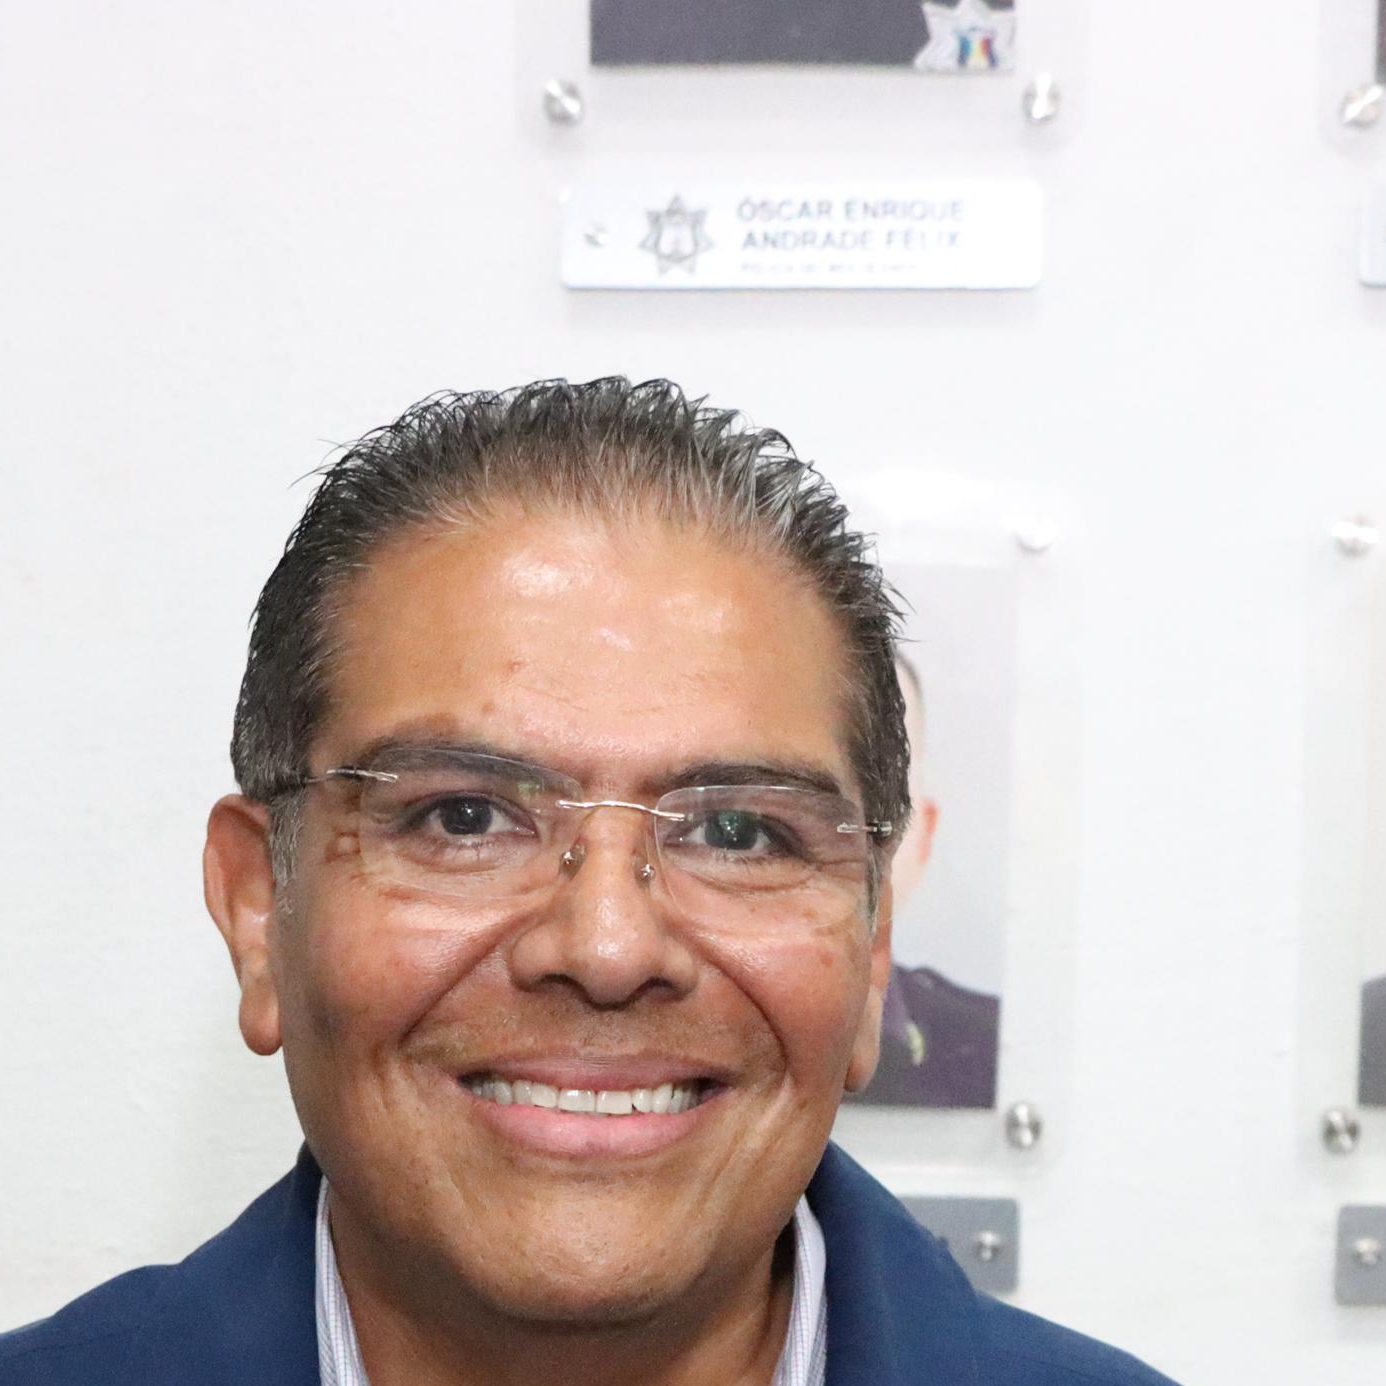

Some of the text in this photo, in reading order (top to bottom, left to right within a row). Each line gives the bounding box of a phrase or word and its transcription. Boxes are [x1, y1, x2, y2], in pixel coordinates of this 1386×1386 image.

[738, 197, 964, 222] ÓSCAR ENRIQUE
[741, 227, 960, 251] ANDRADE FÉLIX
